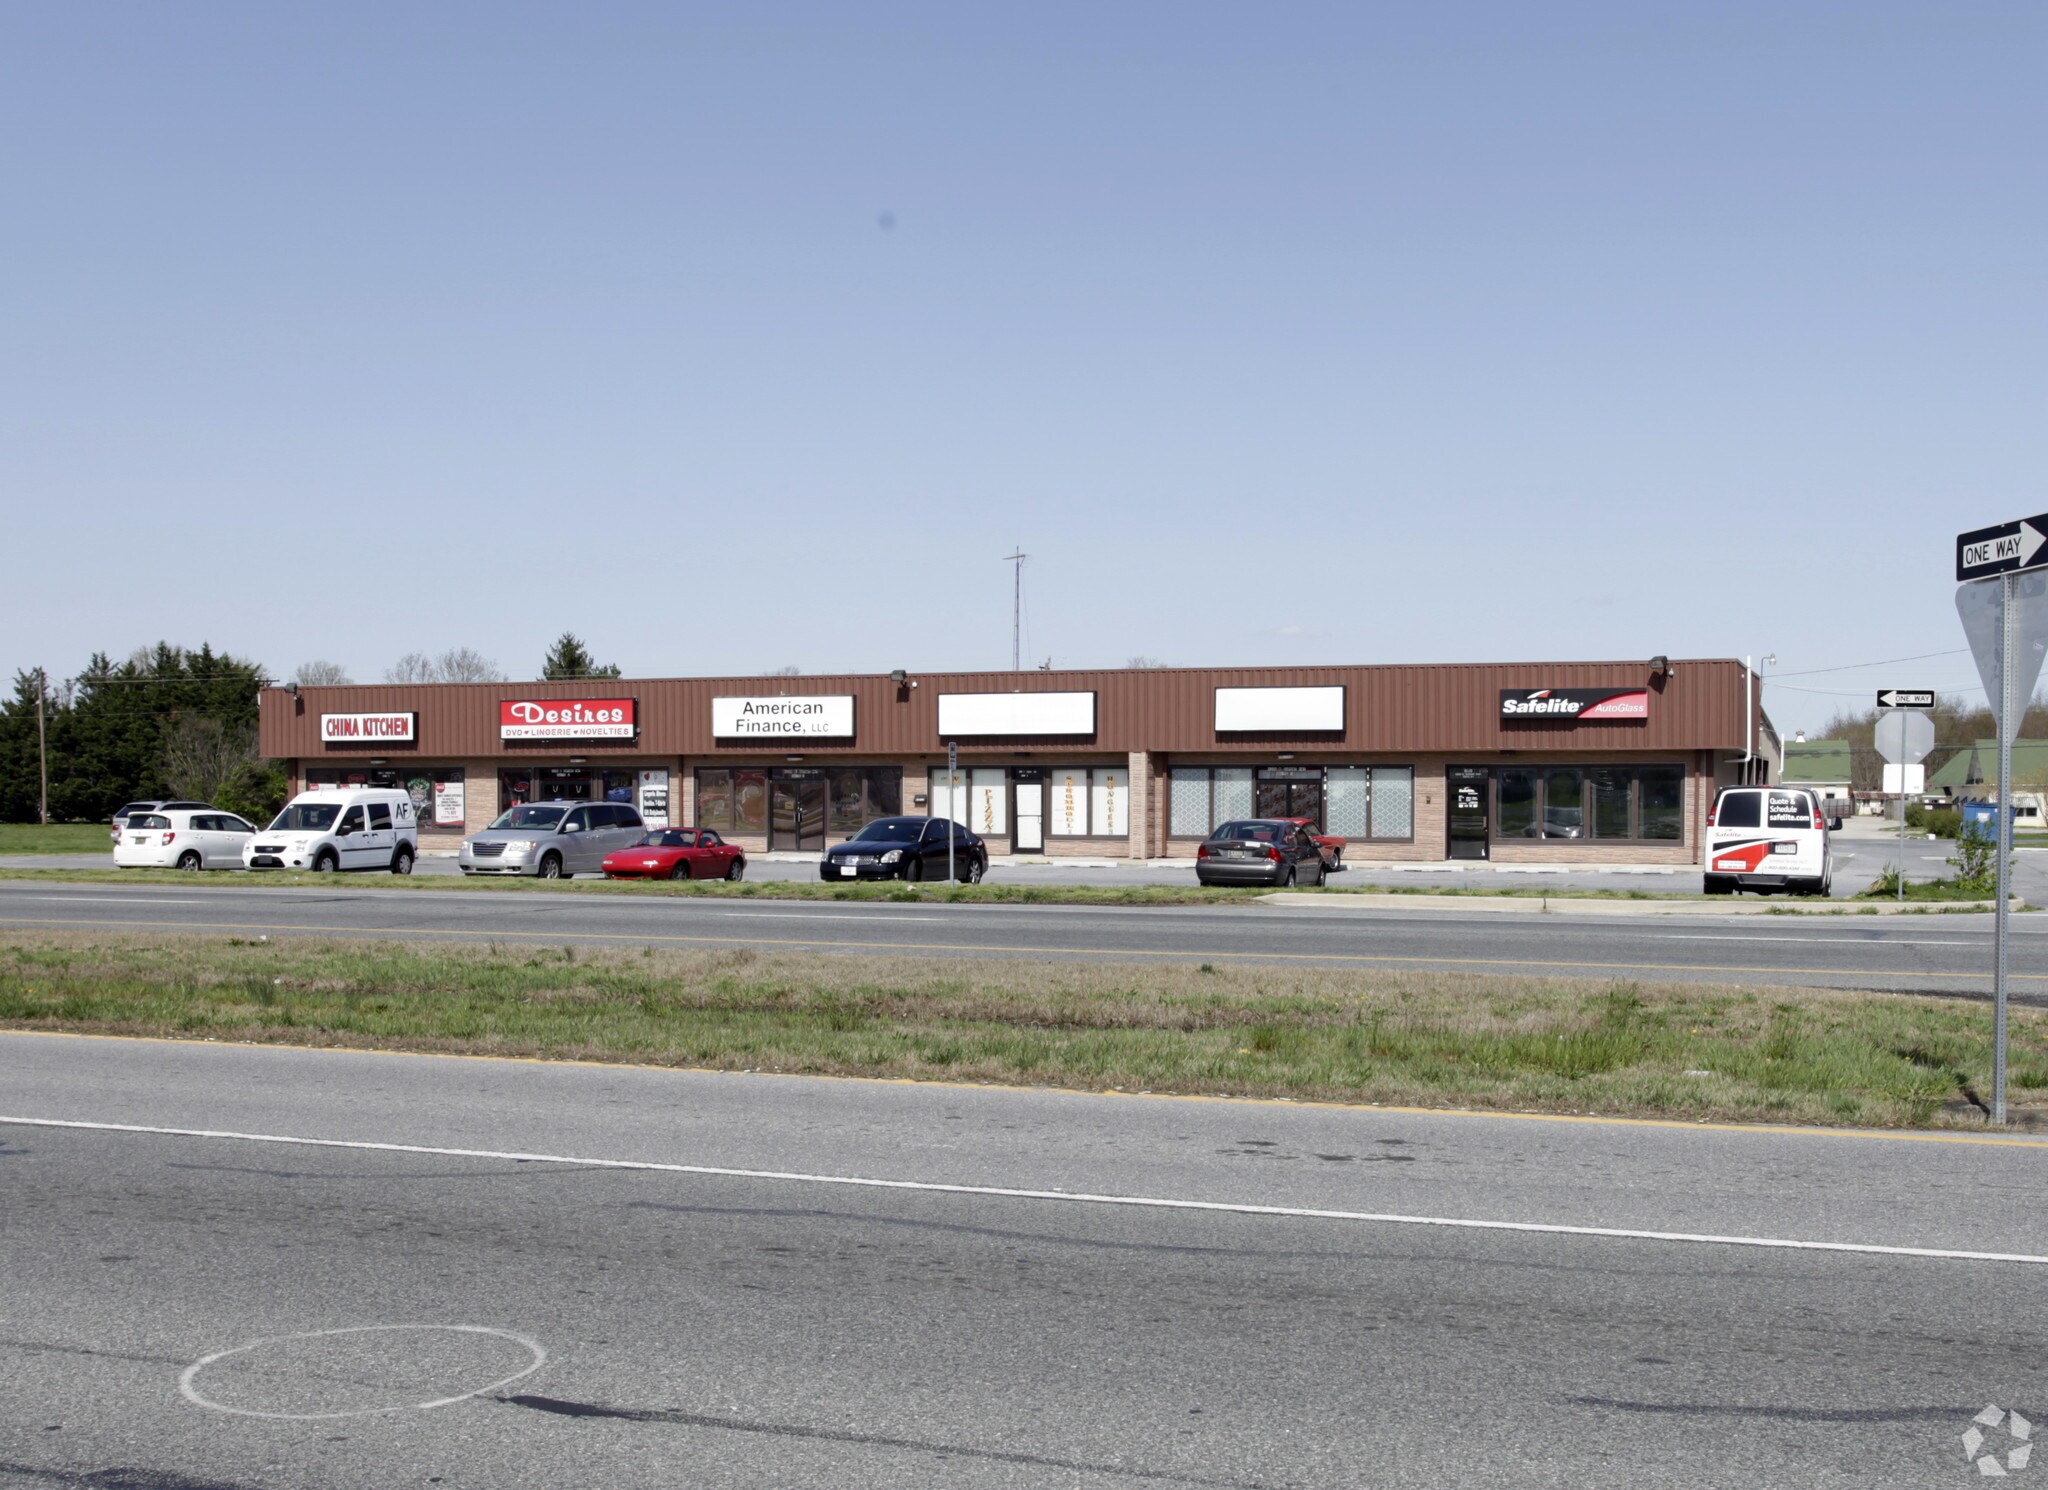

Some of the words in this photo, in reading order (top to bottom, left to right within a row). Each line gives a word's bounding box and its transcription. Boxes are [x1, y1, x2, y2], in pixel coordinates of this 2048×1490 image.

[1965, 544, 1990, 565] ONE
[1996, 536, 2022, 558] WAY
[511, 702, 623, 723] Desires
[743, 701, 823, 715] American
[1502, 698, 1580, 713] Safelite
[1595, 703, 1645, 713] AutoGlass
[326, 718, 360, 737] CHINA
[362, 717, 409, 736] KITCHEN
[531, 728, 571, 736] LINGERIE
[580, 727, 629, 735] NOVELTIES
[736, 719, 806, 734] Finance,
[811, 723, 829, 732] LLC
[985, 789, 993, 831] PIZZA
[1769, 805, 1797, 813] Schedule
